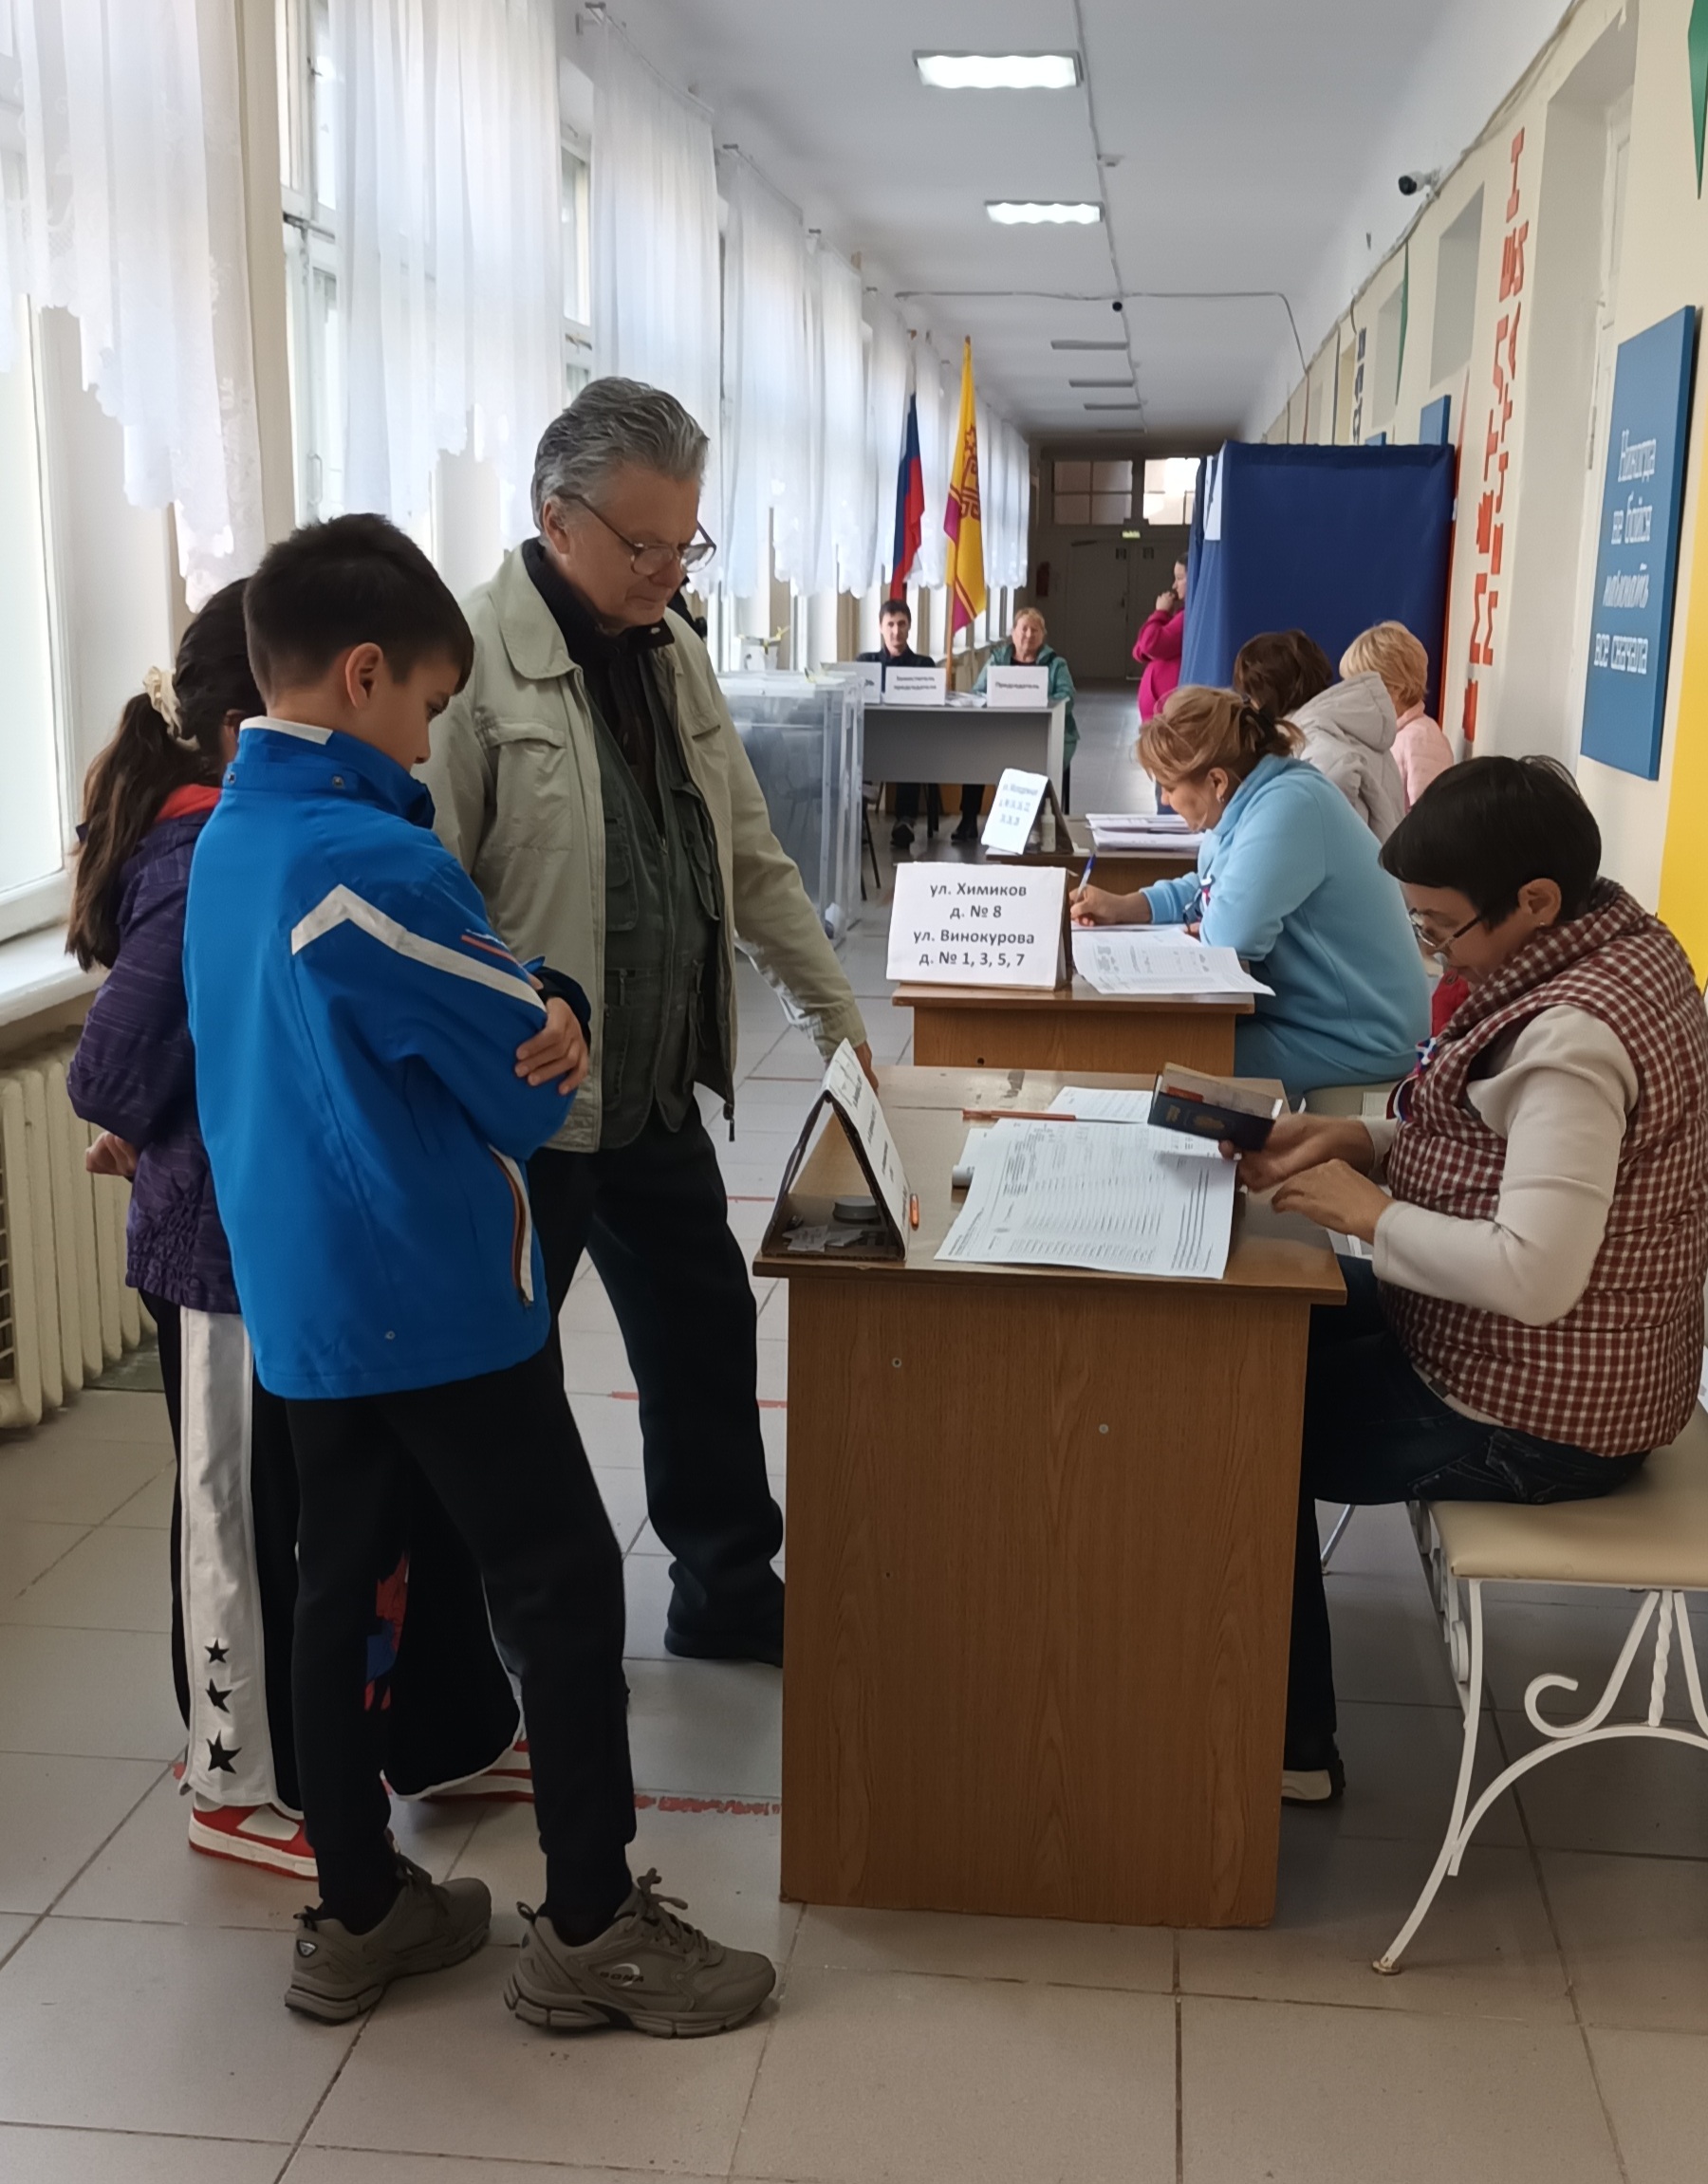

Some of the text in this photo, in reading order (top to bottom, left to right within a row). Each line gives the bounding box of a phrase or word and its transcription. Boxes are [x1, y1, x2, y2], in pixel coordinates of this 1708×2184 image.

[1618, 429, 1656, 483] Никогда
[1610, 490, 1653, 546] не бойся
[930, 882, 1027, 898] ул. Химиков
[950, 904, 1002, 920] д. № 8
[913, 930, 1034, 946] ул. Винокурова
[919, 951, 1025, 968] д. № 1, 3, 5, 7
